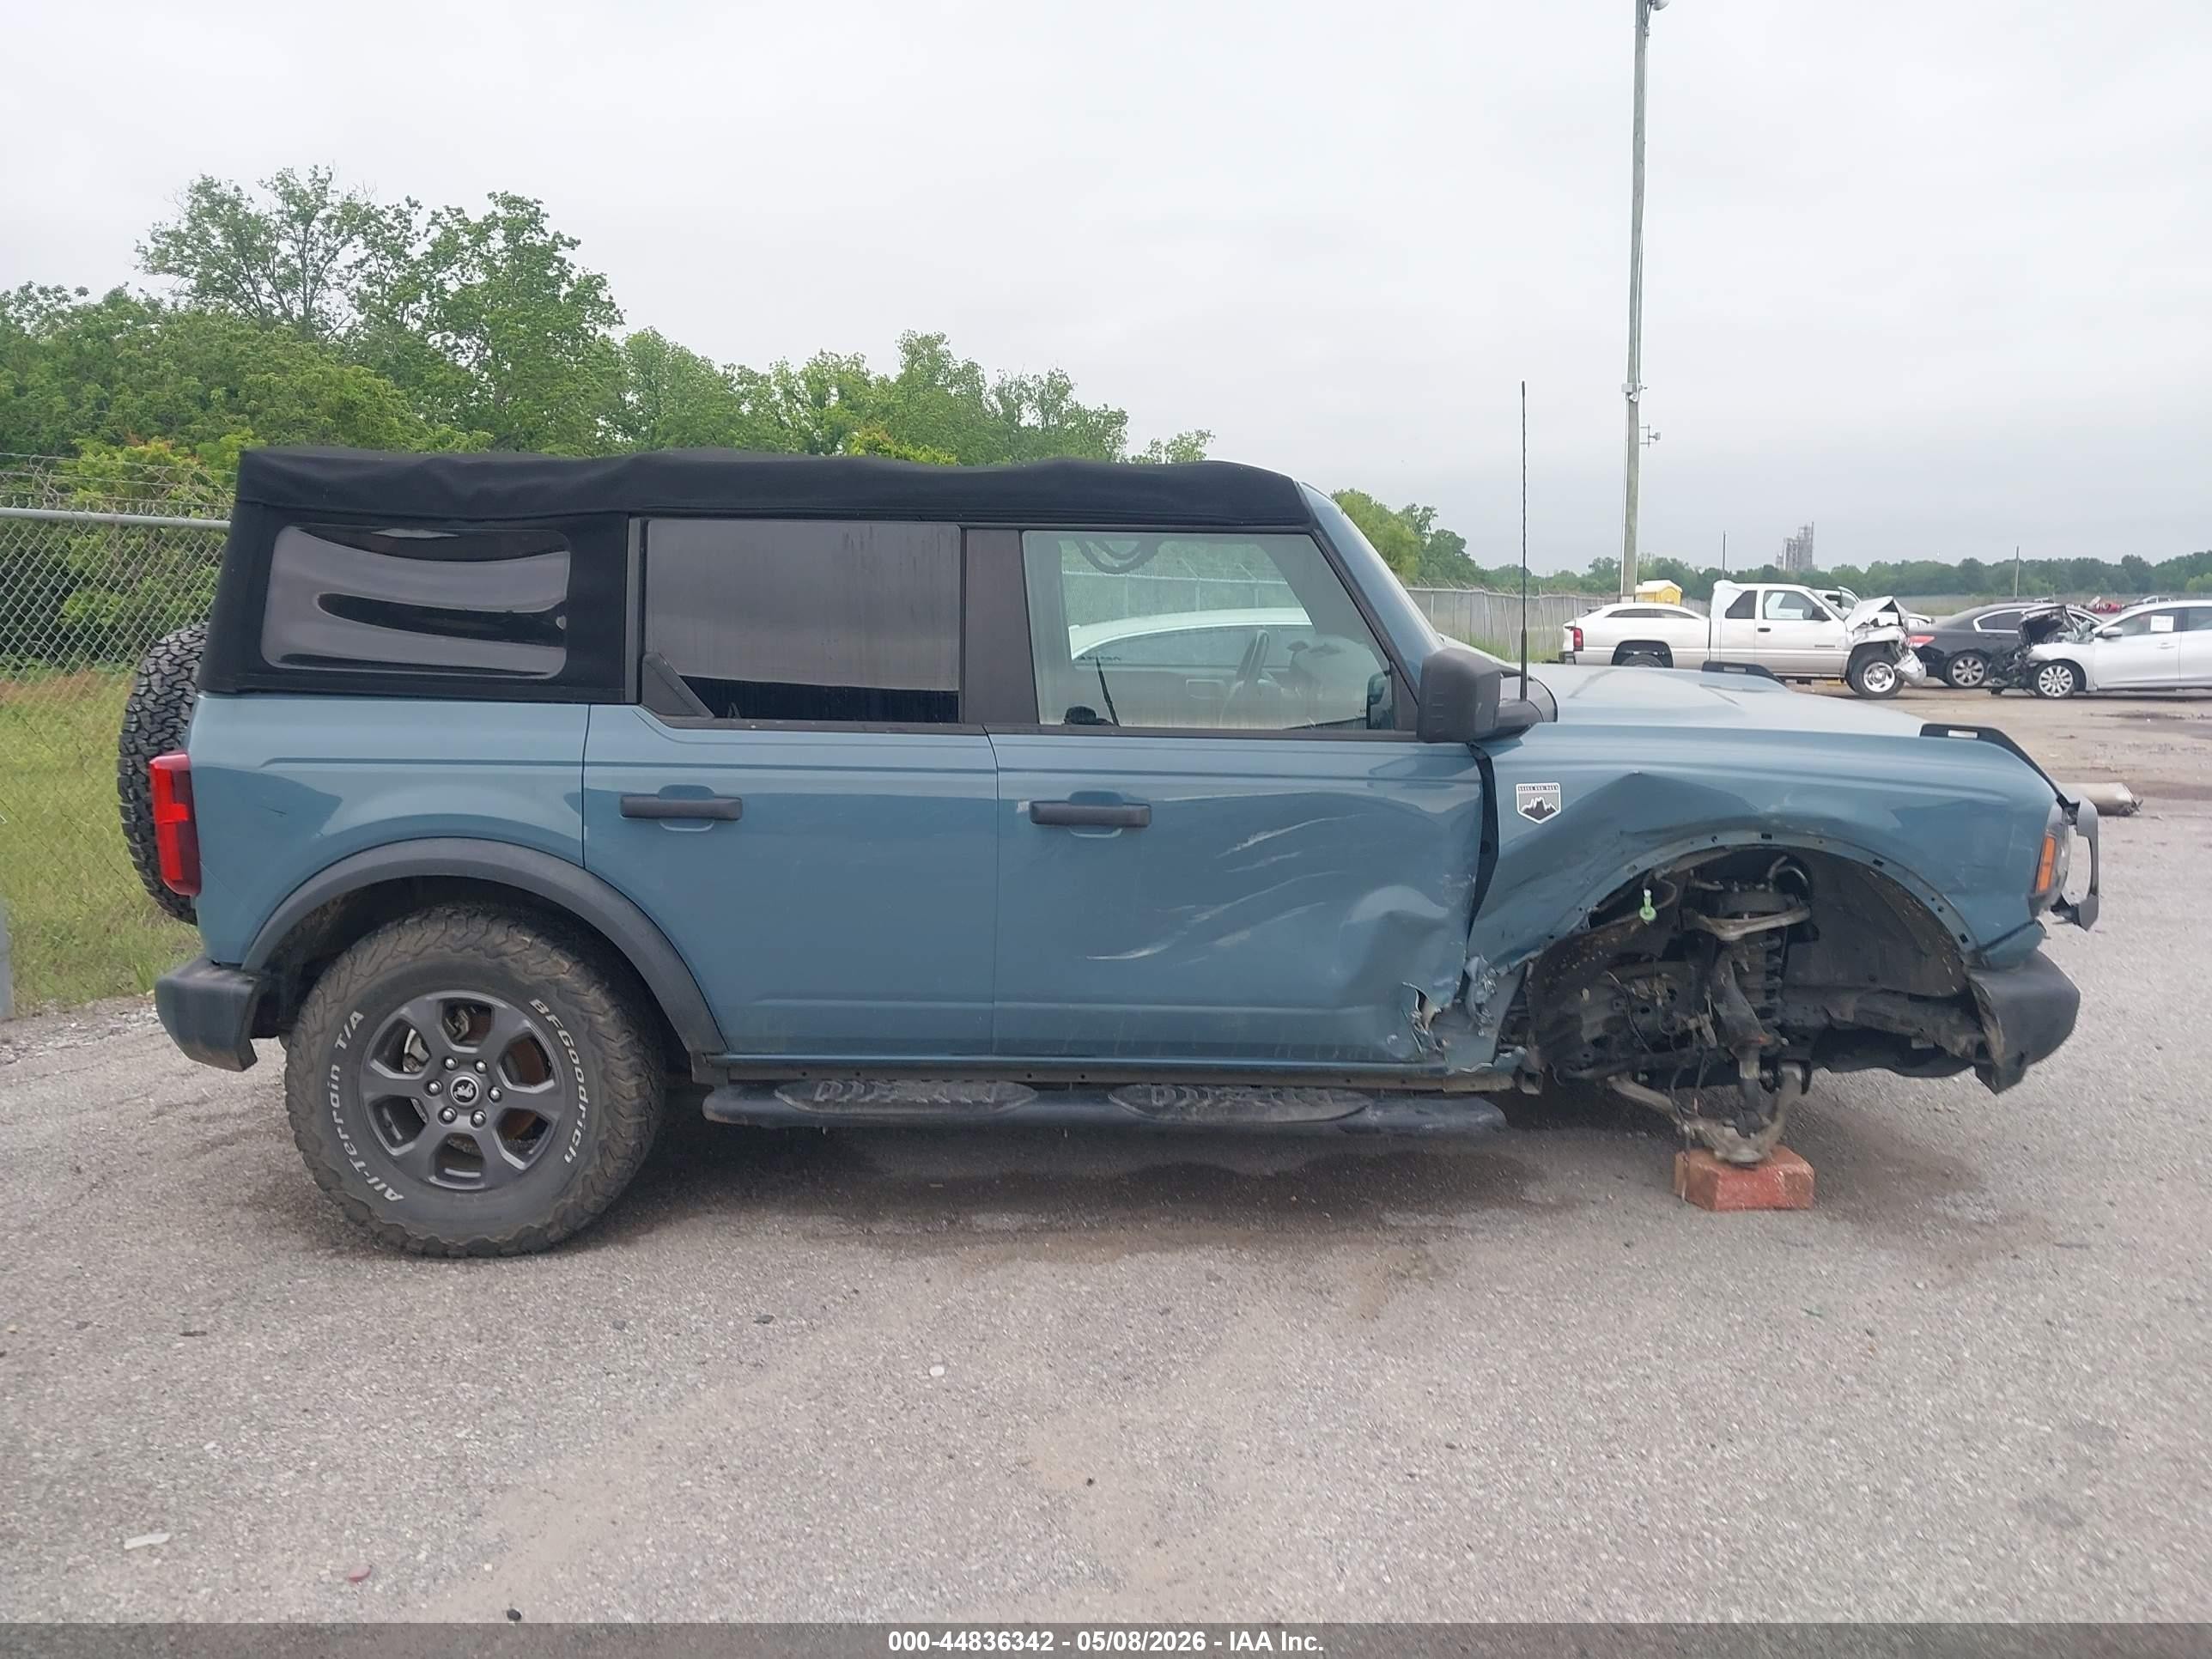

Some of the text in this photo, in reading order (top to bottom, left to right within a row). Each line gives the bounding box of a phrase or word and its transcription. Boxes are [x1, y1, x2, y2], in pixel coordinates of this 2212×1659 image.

[327, 1011, 404, 1201] All-Terrain T/A
[529, 999, 588, 1164] BFGoodrich
